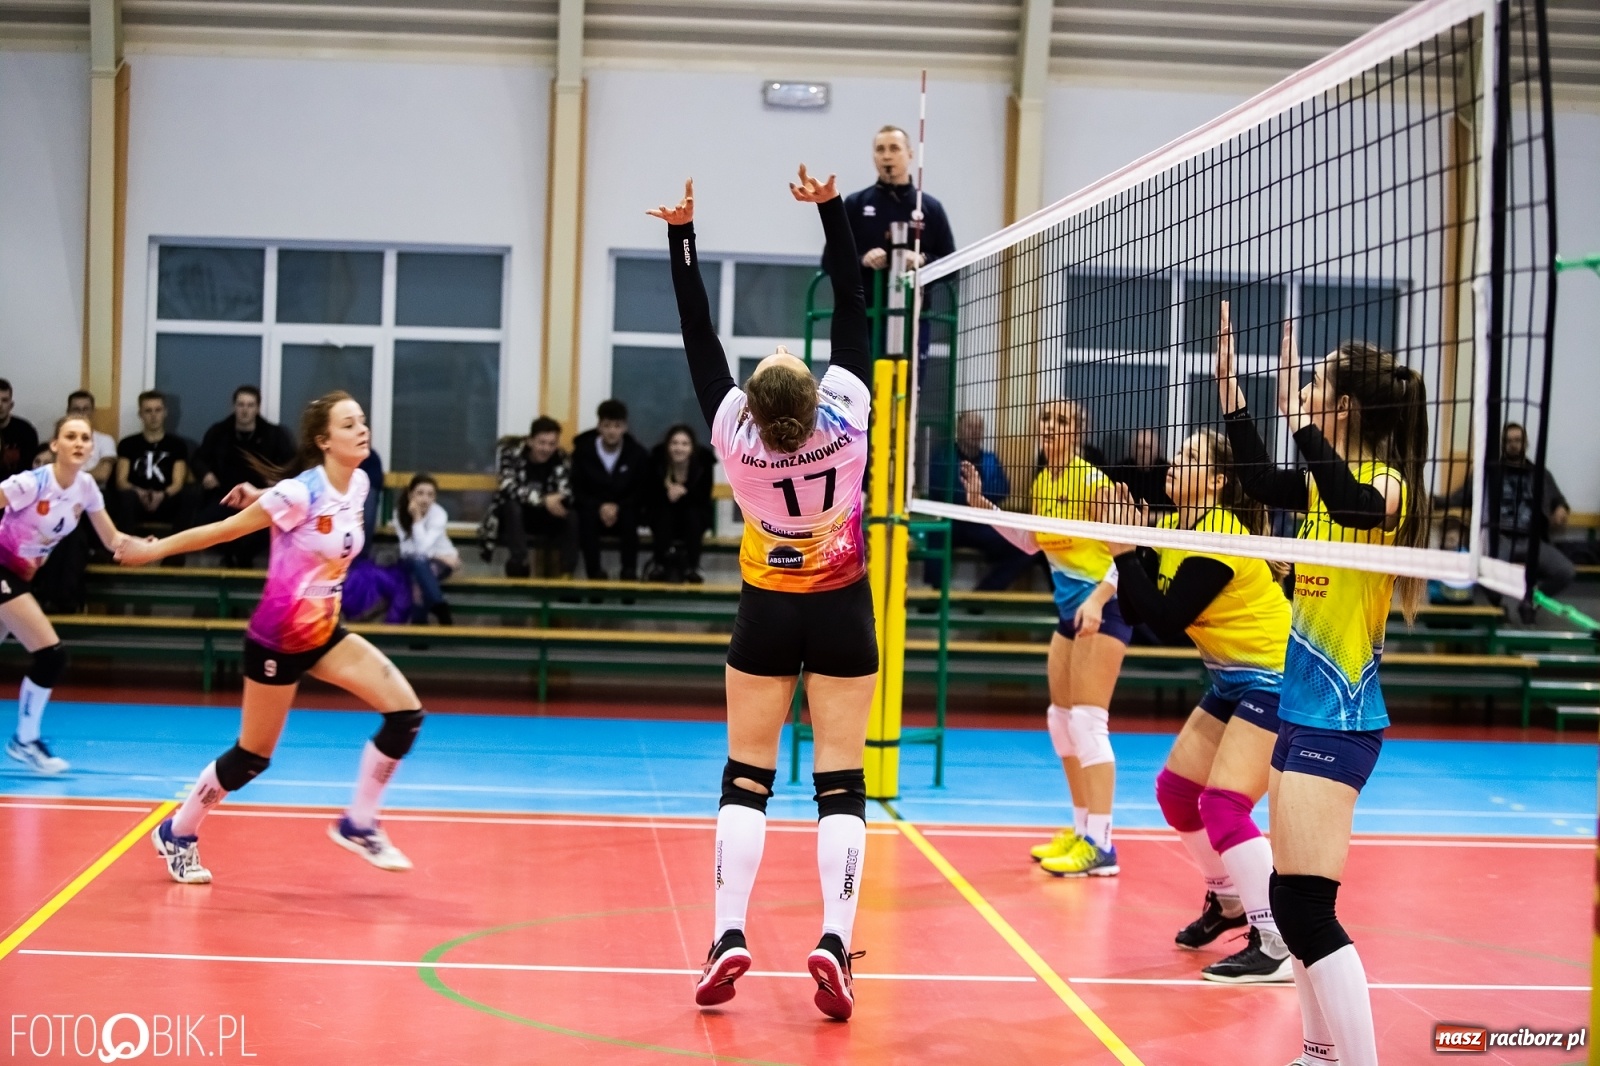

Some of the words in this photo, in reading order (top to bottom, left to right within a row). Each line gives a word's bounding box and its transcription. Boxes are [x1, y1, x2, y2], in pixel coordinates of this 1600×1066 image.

[741, 453, 767, 468] UKS
[773, 467, 836, 518] 17
[769, 556, 802, 565] ABSTRAKT
